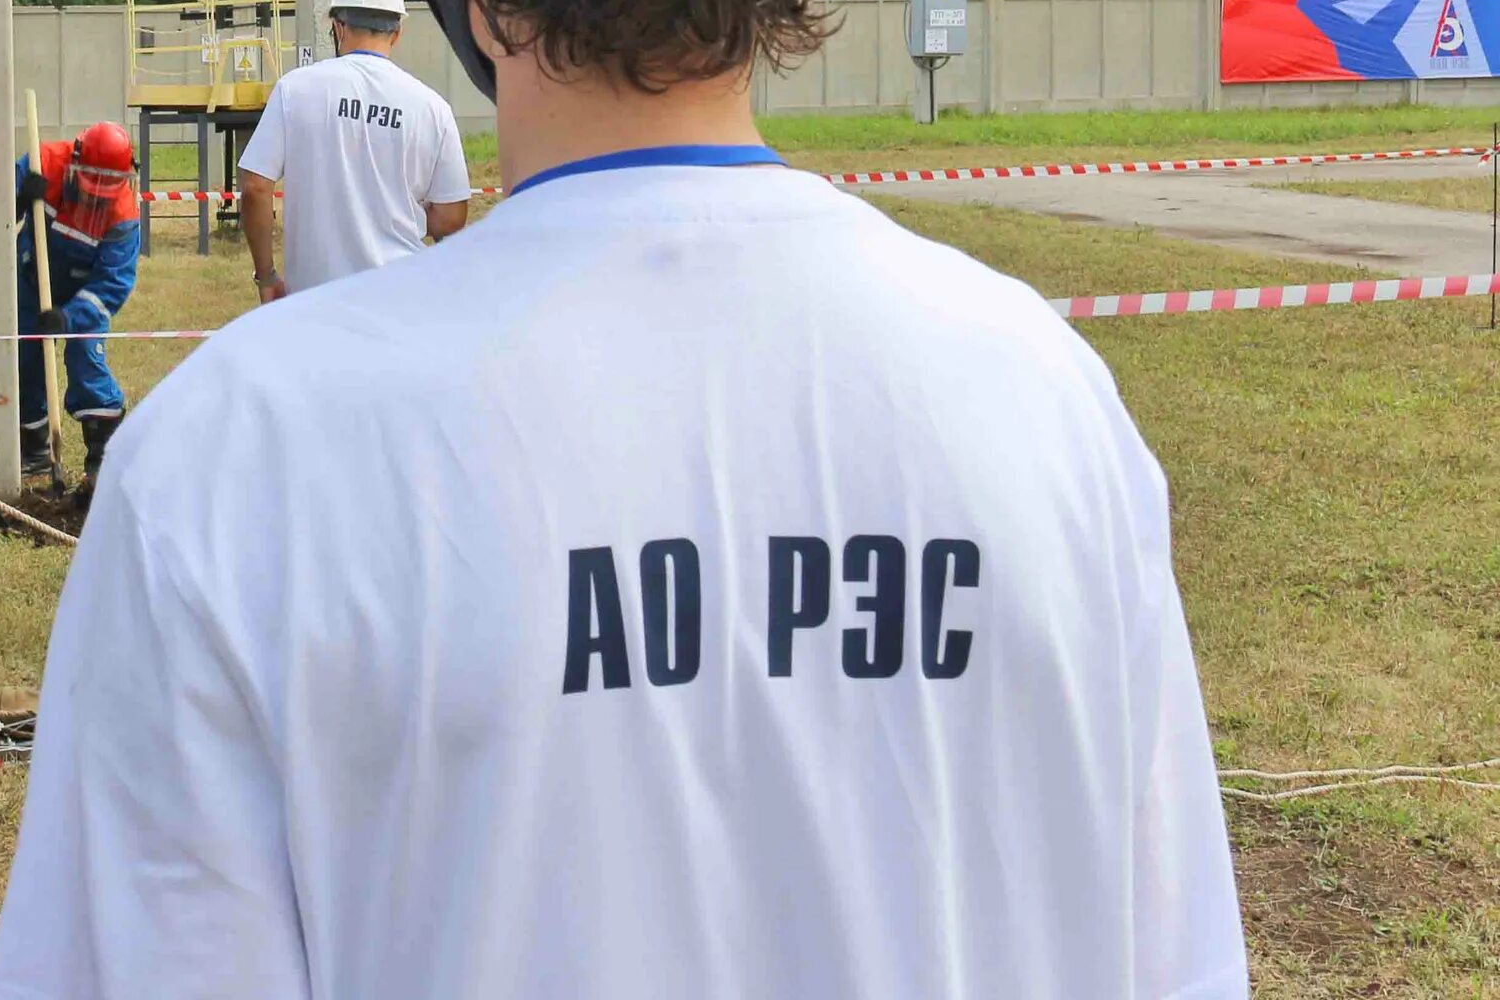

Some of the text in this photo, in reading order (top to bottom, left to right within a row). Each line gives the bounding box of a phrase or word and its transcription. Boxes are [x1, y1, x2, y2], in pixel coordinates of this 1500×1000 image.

[338, 98, 403, 129] АО РЭС
[562, 534, 981, 695] АО РЭС
